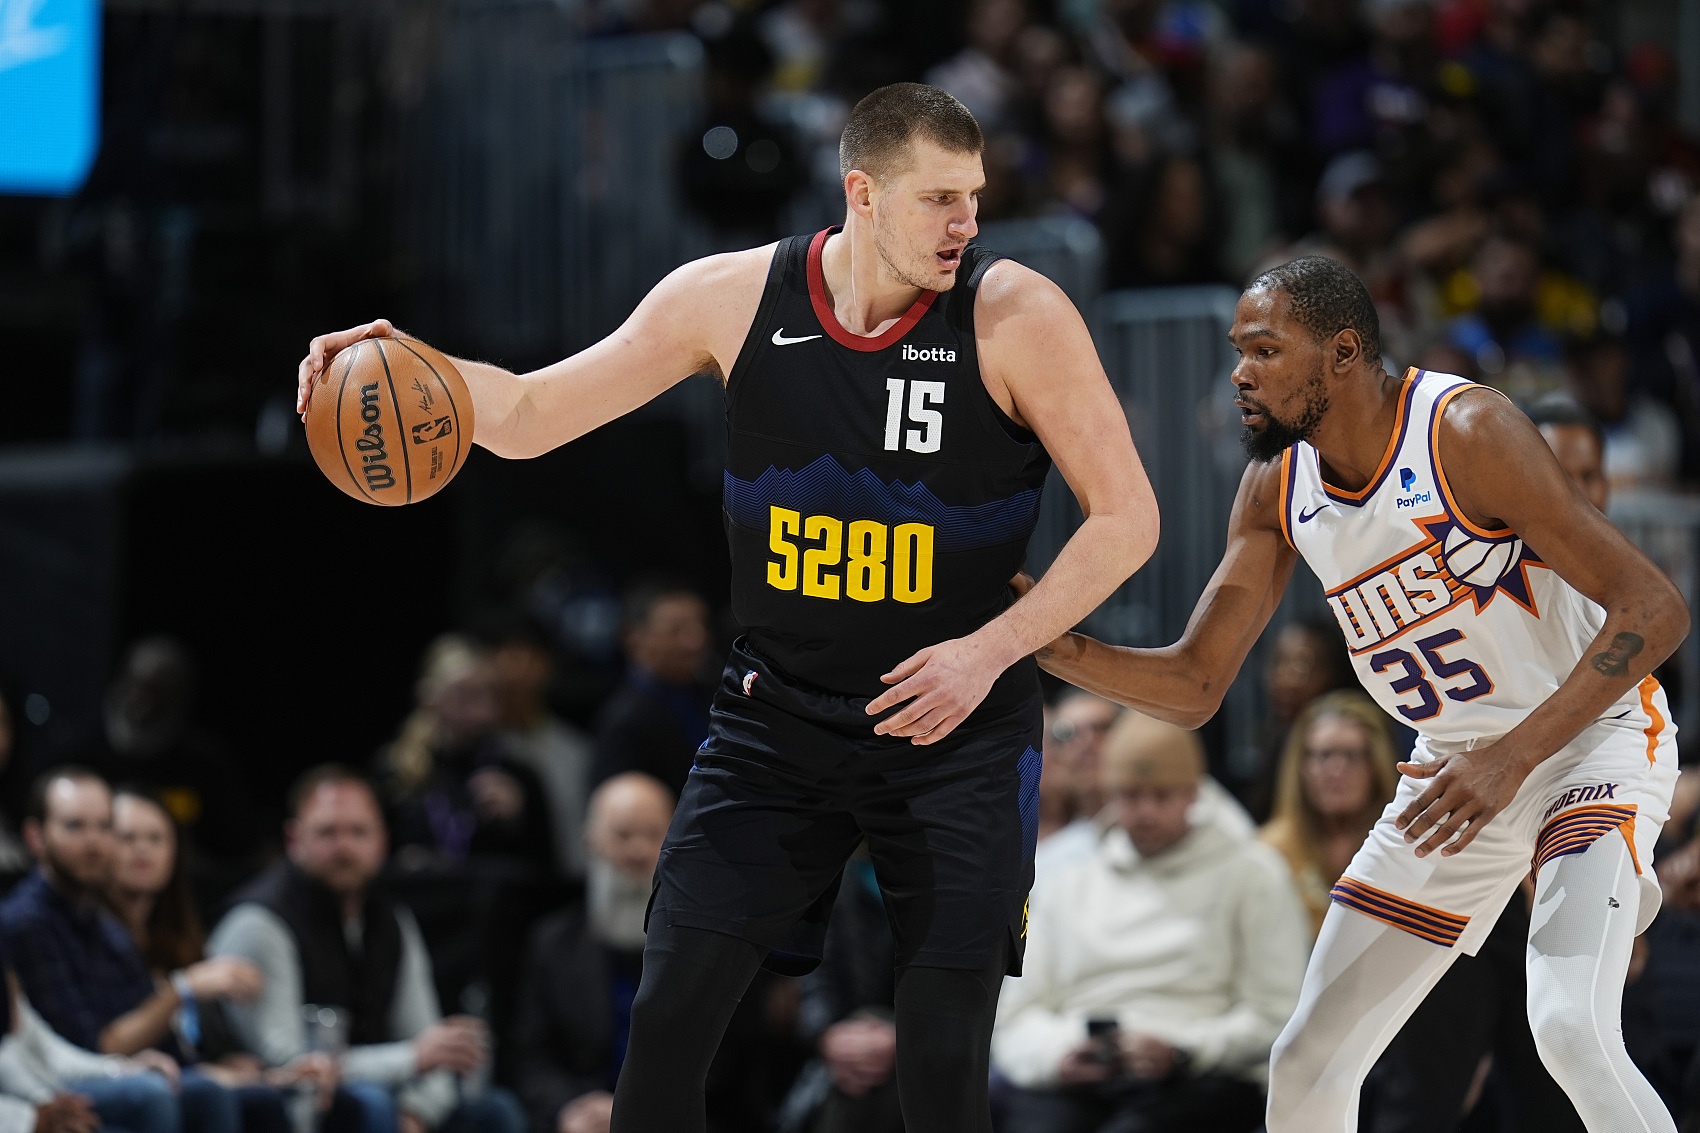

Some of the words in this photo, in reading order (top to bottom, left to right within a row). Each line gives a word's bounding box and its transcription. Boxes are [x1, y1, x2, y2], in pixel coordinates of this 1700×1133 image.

[902, 344, 956, 362] ibotta
[356, 380, 397, 492] Wilson
[884, 378, 946, 454] 15
[1396, 491, 1431, 509] PayPal
[766, 505, 935, 604] 5280
[1326, 552, 1451, 650] UNS
[1369, 627, 1495, 723] 35
